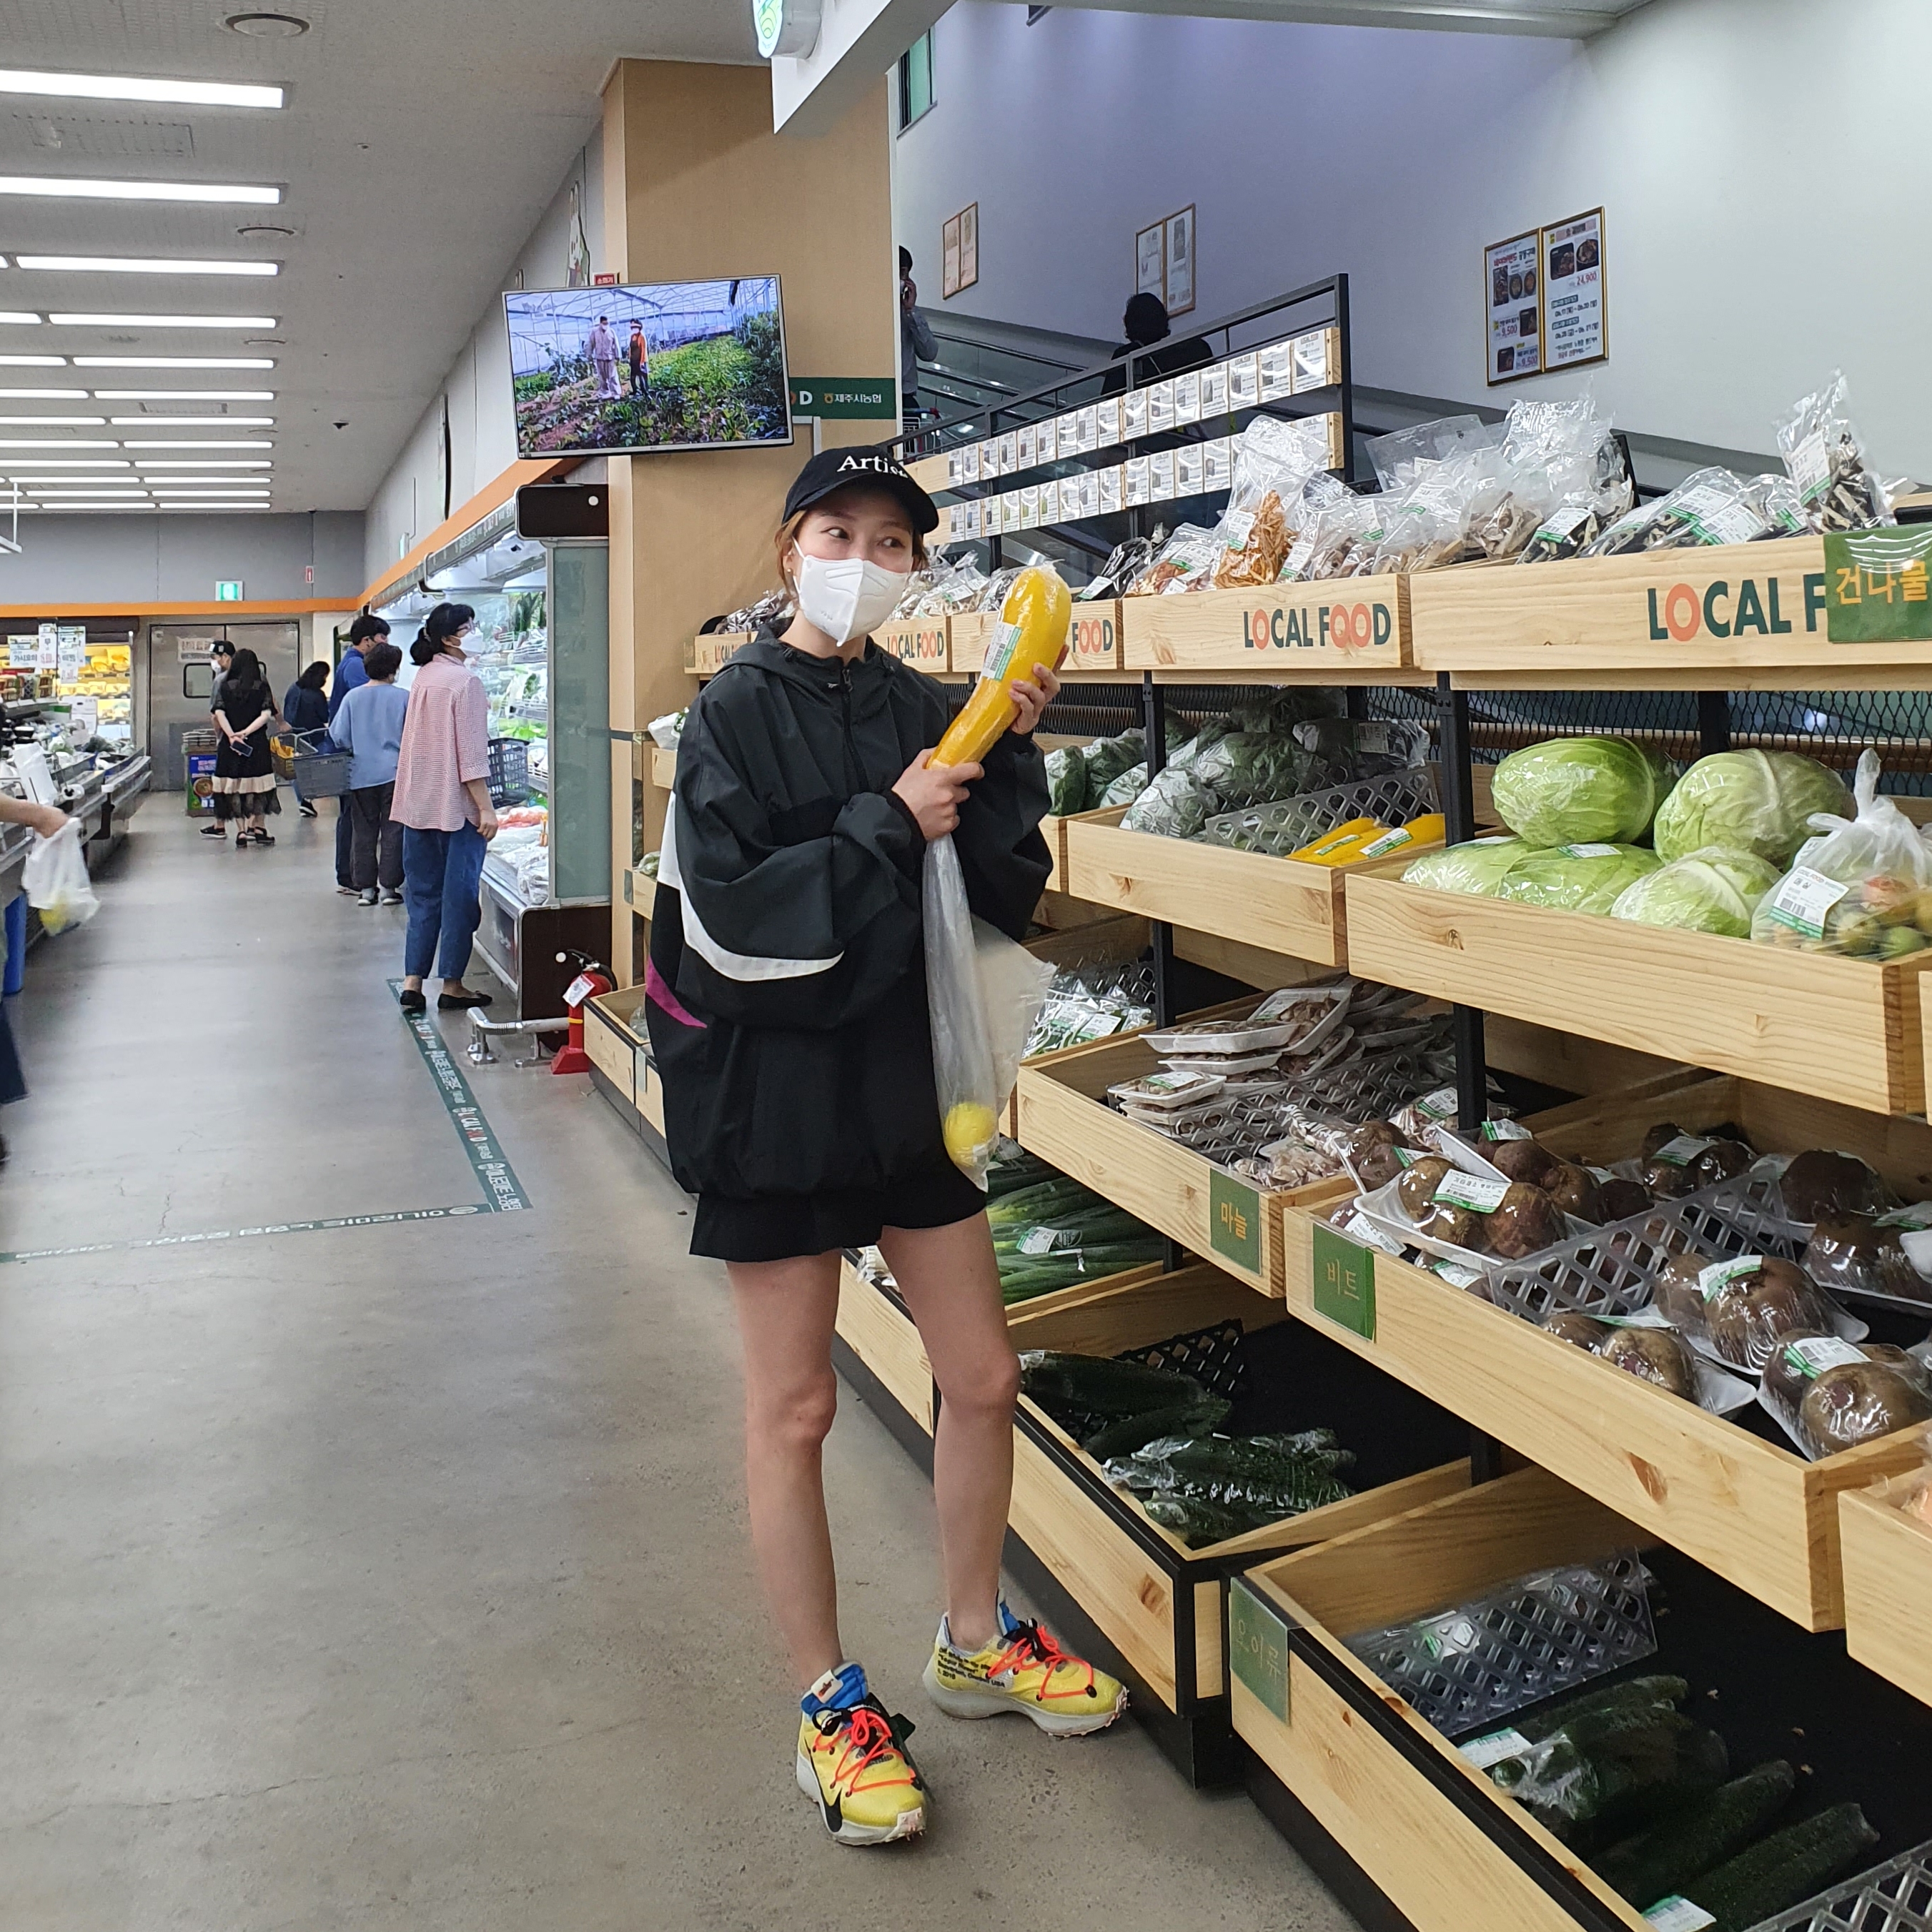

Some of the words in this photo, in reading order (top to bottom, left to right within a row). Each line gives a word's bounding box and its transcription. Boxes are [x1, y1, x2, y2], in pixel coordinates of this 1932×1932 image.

[834, 392, 882, 404] 제주시농협
[1835, 559, 1931, 606] 건나물
[1244, 609, 1314, 650] LOCAL
[1318, 603, 1391, 648] FOOD
[1647, 577, 1792, 642] LOCAL
[887, 634, 915, 658] LOCAL
[916, 630, 944, 659] FOOD
[1071, 619, 1114, 654] FOOD
[1220, 1201, 1248, 1241] 마늘
[1326, 1258, 1360, 1301] 비트
